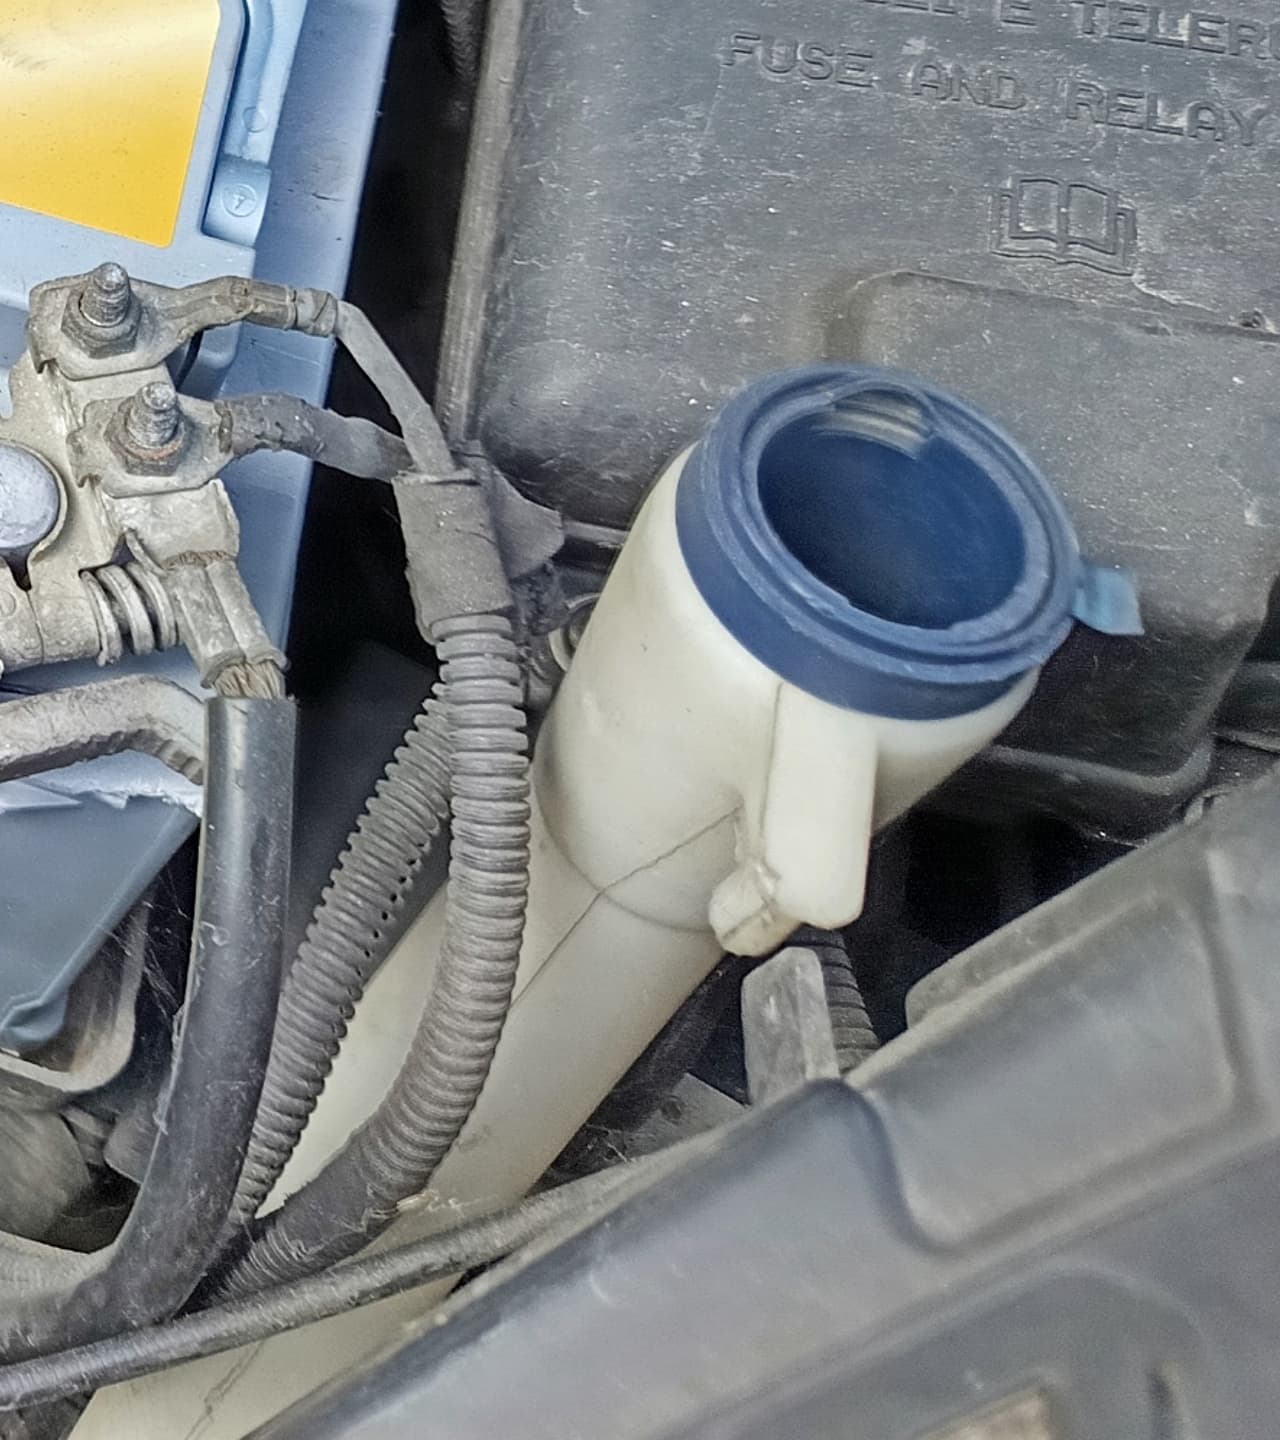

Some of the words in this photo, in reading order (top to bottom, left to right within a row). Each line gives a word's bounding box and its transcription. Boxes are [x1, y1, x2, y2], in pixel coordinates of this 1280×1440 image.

[722, 31, 874, 89] FUSE
[911, 62, 1028, 112] AND
[1065, 80, 1269, 147] RELAY
